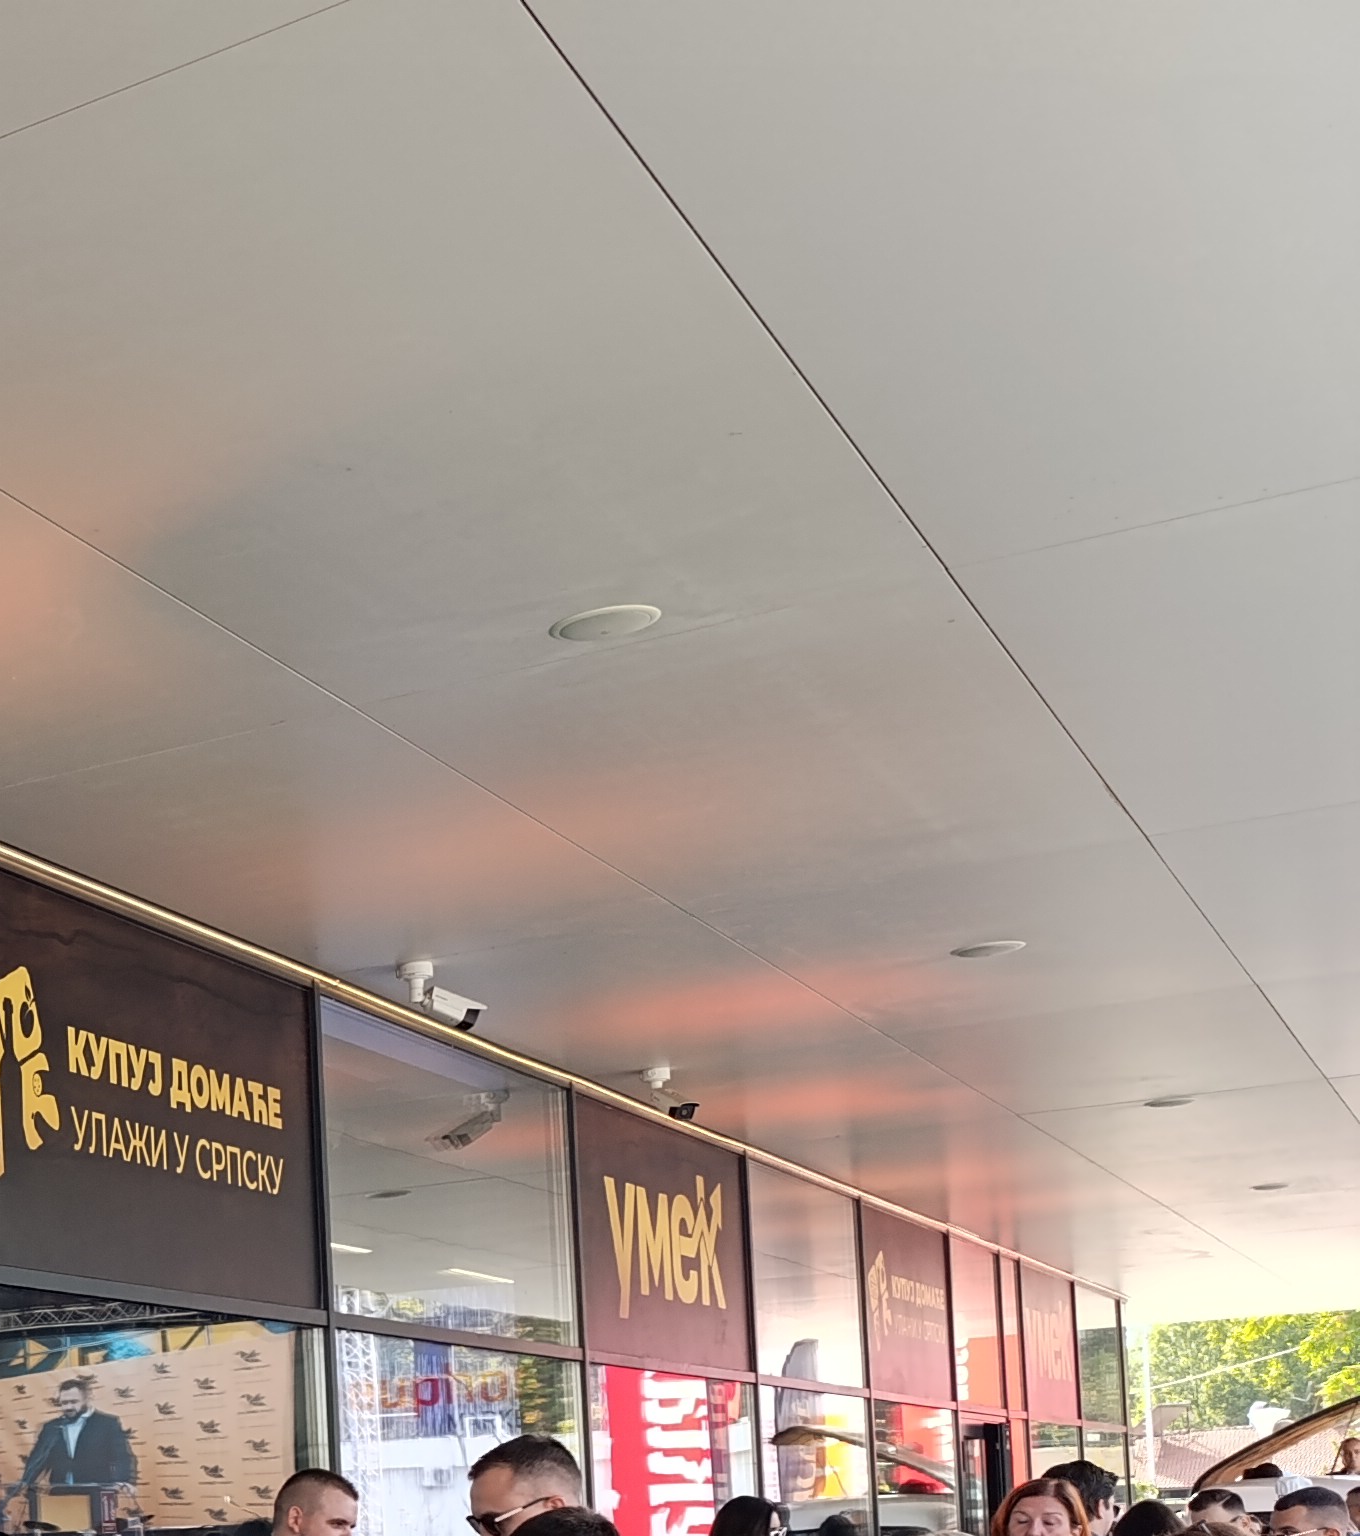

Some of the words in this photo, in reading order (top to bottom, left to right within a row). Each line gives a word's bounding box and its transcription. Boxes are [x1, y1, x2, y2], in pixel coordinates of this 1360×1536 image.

[67, 1025, 163, 1096] КУПУЈ
[170, 1057, 283, 1130] ДОМАЋЕ
[69, 1105, 168, 1171] УЛАЖИ
[173, 1131, 190, 1174] У
[195, 1138, 284, 1195] СРПСКУ
